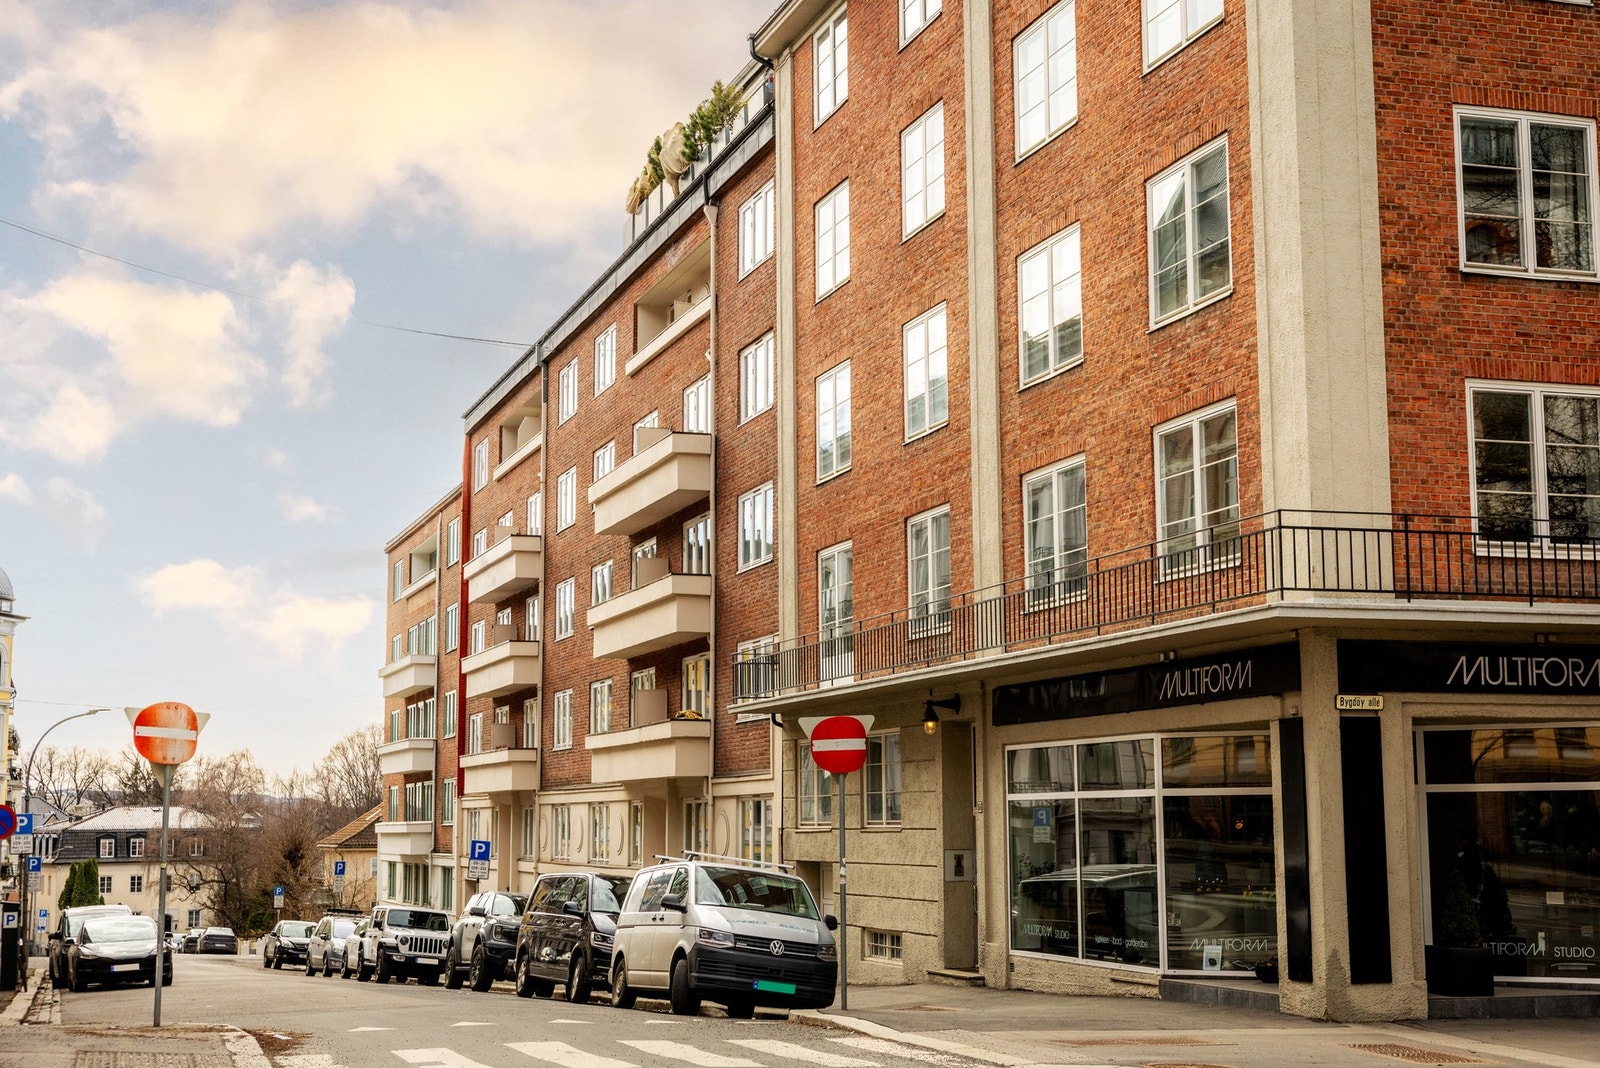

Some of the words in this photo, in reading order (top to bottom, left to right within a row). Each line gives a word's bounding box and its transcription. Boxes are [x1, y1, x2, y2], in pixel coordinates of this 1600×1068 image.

[1160, 660, 1251, 700] MULTIFORM
[16, 816, 28, 832] P
[474, 843, 486, 858] P
[29, 859, 38, 870] P
[336, 863, 344, 873] P
[276, 887, 282, 895] P
[6, 914, 15, 926] P
[1022, 923, 1053, 937] MULTIFORM
[1054, 929, 1070, 940] STUDIO
[1554, 946, 1596, 958] STUDIO
